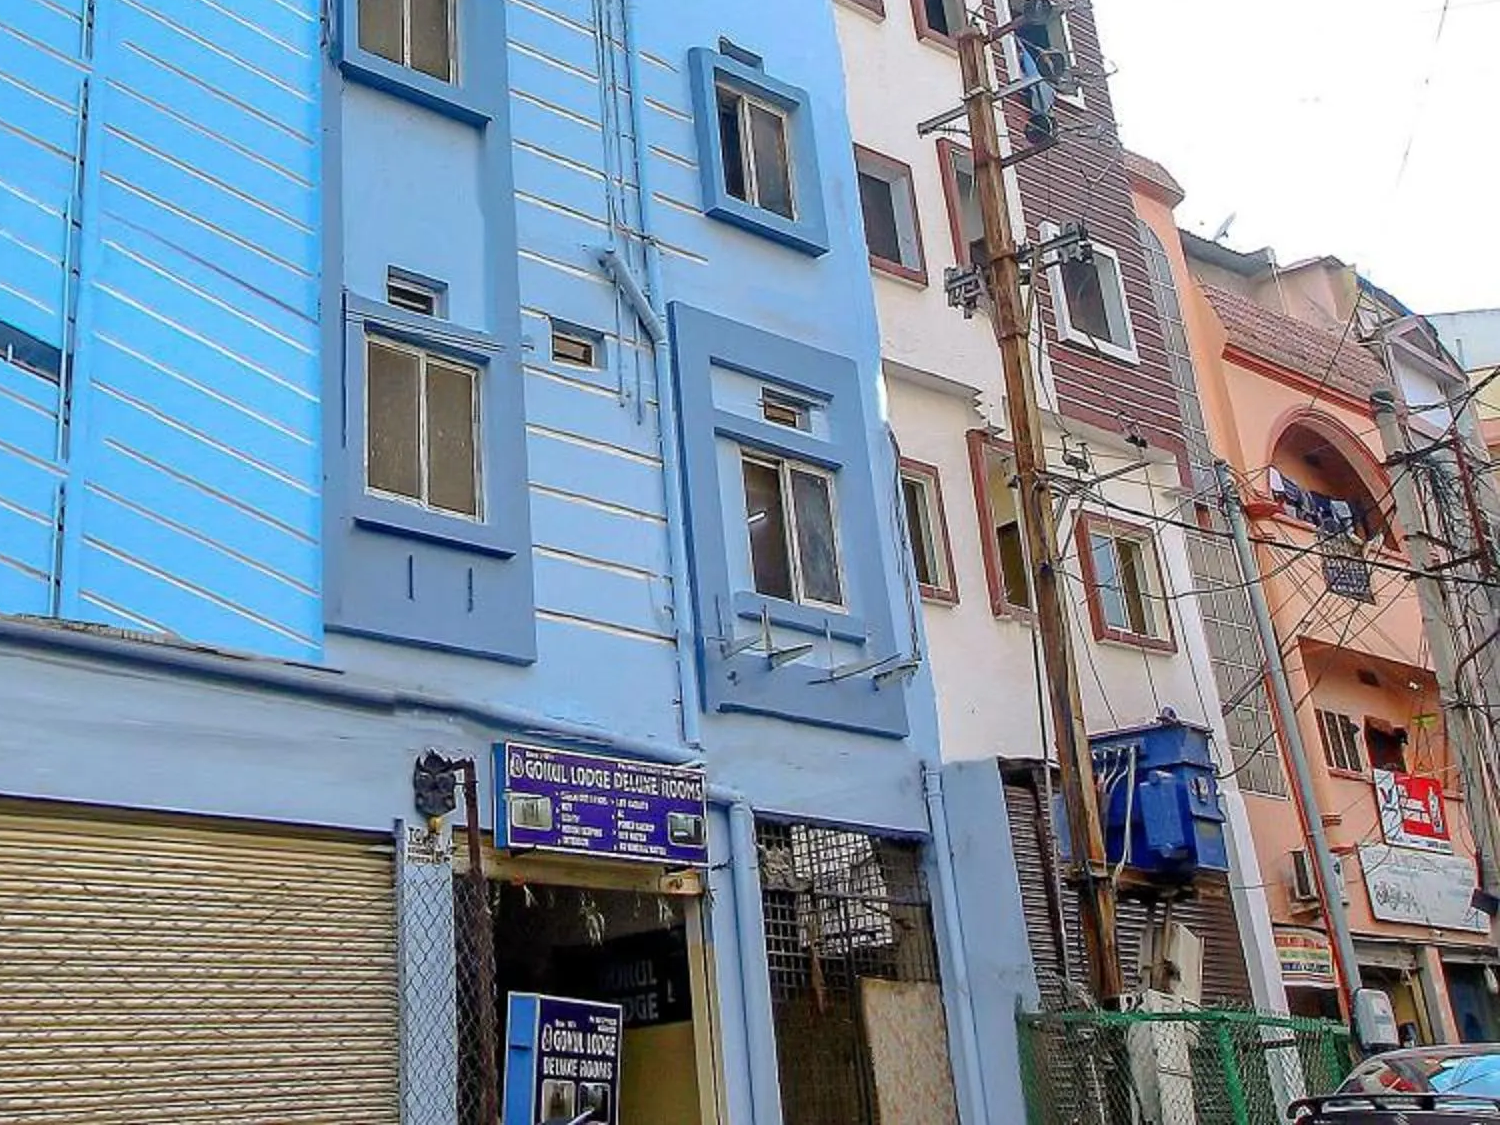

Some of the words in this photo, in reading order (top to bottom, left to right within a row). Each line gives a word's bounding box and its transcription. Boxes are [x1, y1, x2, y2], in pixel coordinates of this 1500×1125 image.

[525, 760, 568, 784] GOKUL
[571, 766, 610, 790] LODGE
[613, 771, 659, 796] DELUXE
[661, 777, 702, 802] ROOMS
[587, 1032, 616, 1057] LODGE
[543, 1056, 578, 1077] DELUXE
[580, 1059, 612, 1080] ROOMS
